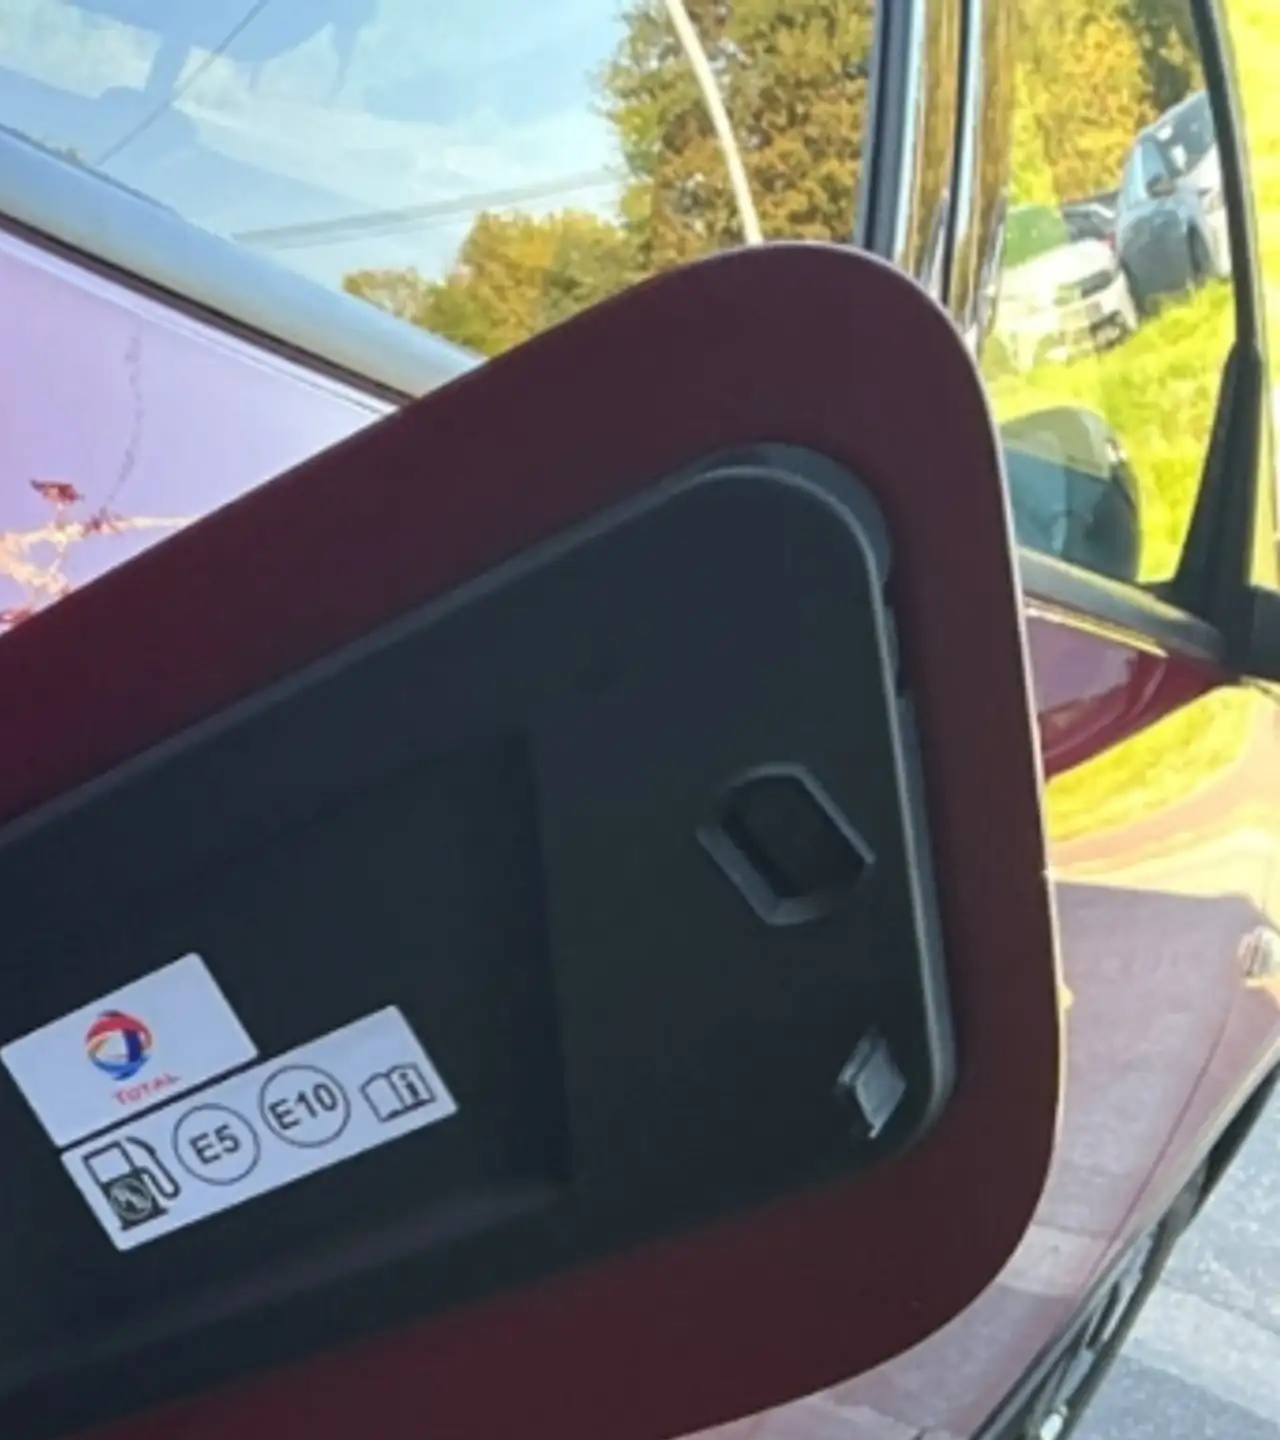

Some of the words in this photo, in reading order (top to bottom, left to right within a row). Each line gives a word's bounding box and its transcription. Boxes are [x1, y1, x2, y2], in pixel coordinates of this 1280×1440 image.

[112, 1072, 181, 1105] TOTAL
[189, 1123, 241, 1165] E5
[268, 1082, 339, 1131] E10
